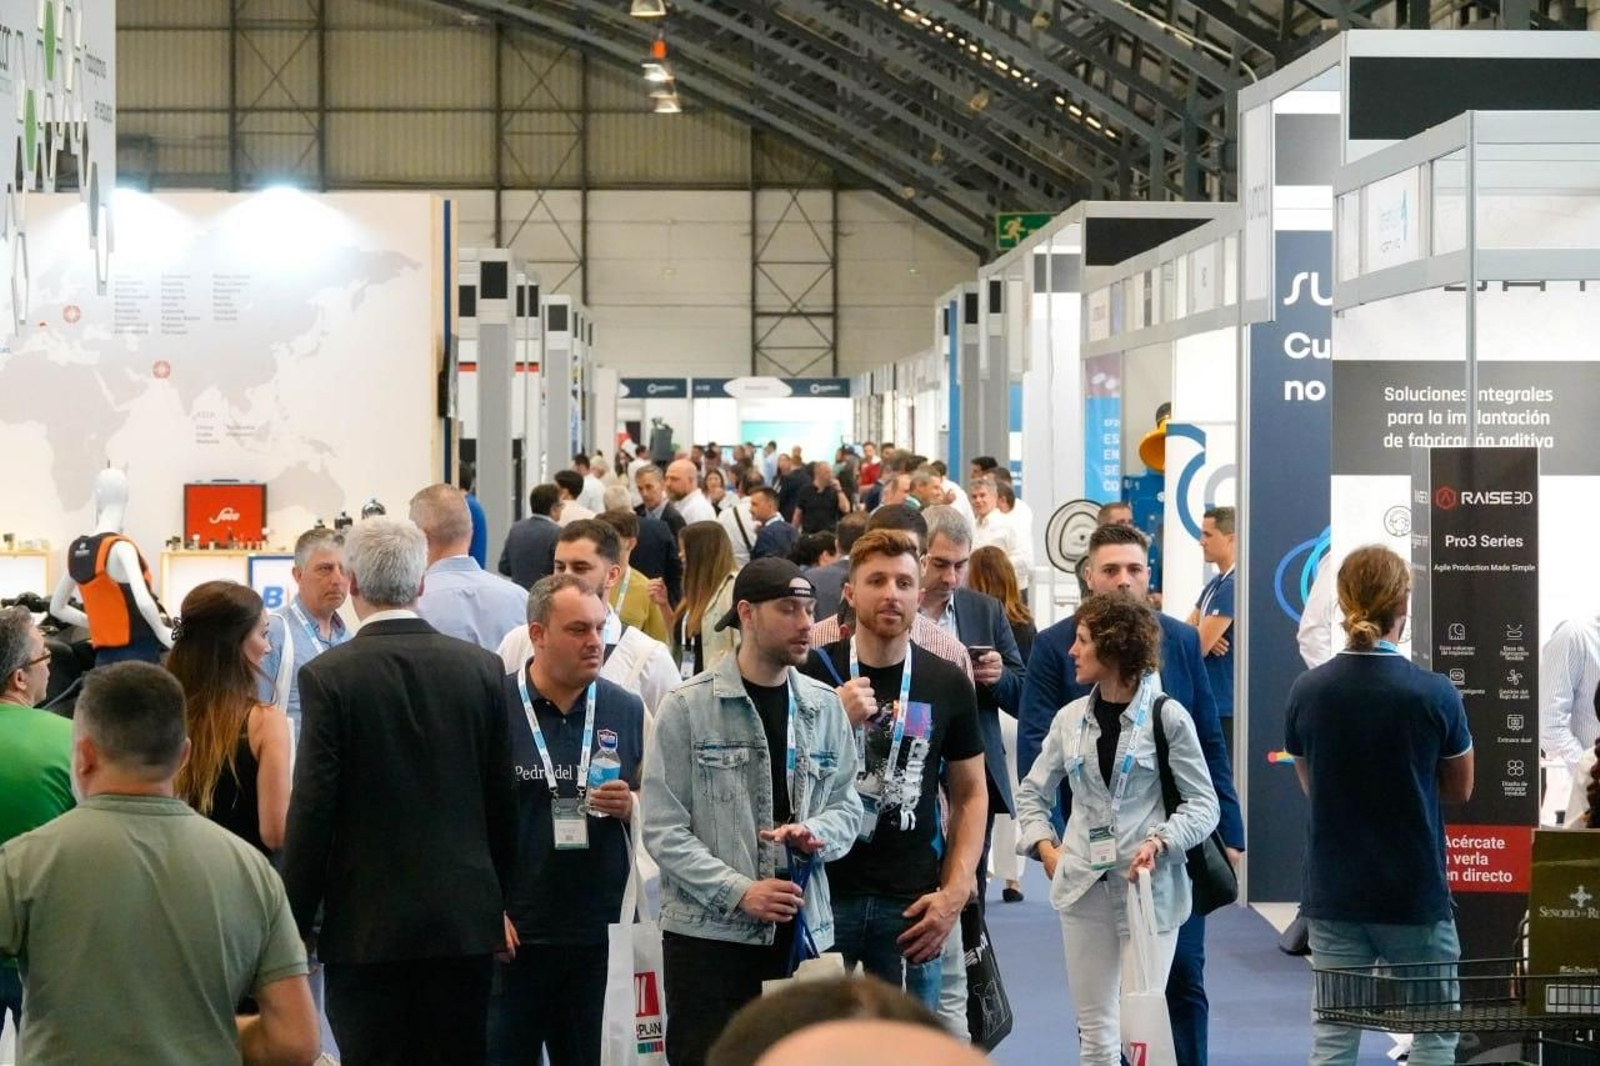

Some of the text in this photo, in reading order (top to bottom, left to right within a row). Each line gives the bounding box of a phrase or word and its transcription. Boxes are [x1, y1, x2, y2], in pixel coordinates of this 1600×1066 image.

[1284, 380, 1327, 401] no
[1478, 386, 1554, 404] ntegrales
[1388, 409, 1550, 427] para la imlantación
[1383, 433, 1403, 448] de
[1461, 490, 1533, 505] RAISE3D
[1445, 534, 1477, 548] Pro3
[1480, 534, 1524, 548] Series
[1434, 563, 1450, 573] Agile
[1453, 563, 1489, 572] Production
[1491, 563, 1510, 572] Made
[1512, 563, 1536, 573] Simple
[554, 764, 572, 780] del
[1453, 851, 1489, 865] verla
[1462, 868, 1513, 883] directo
